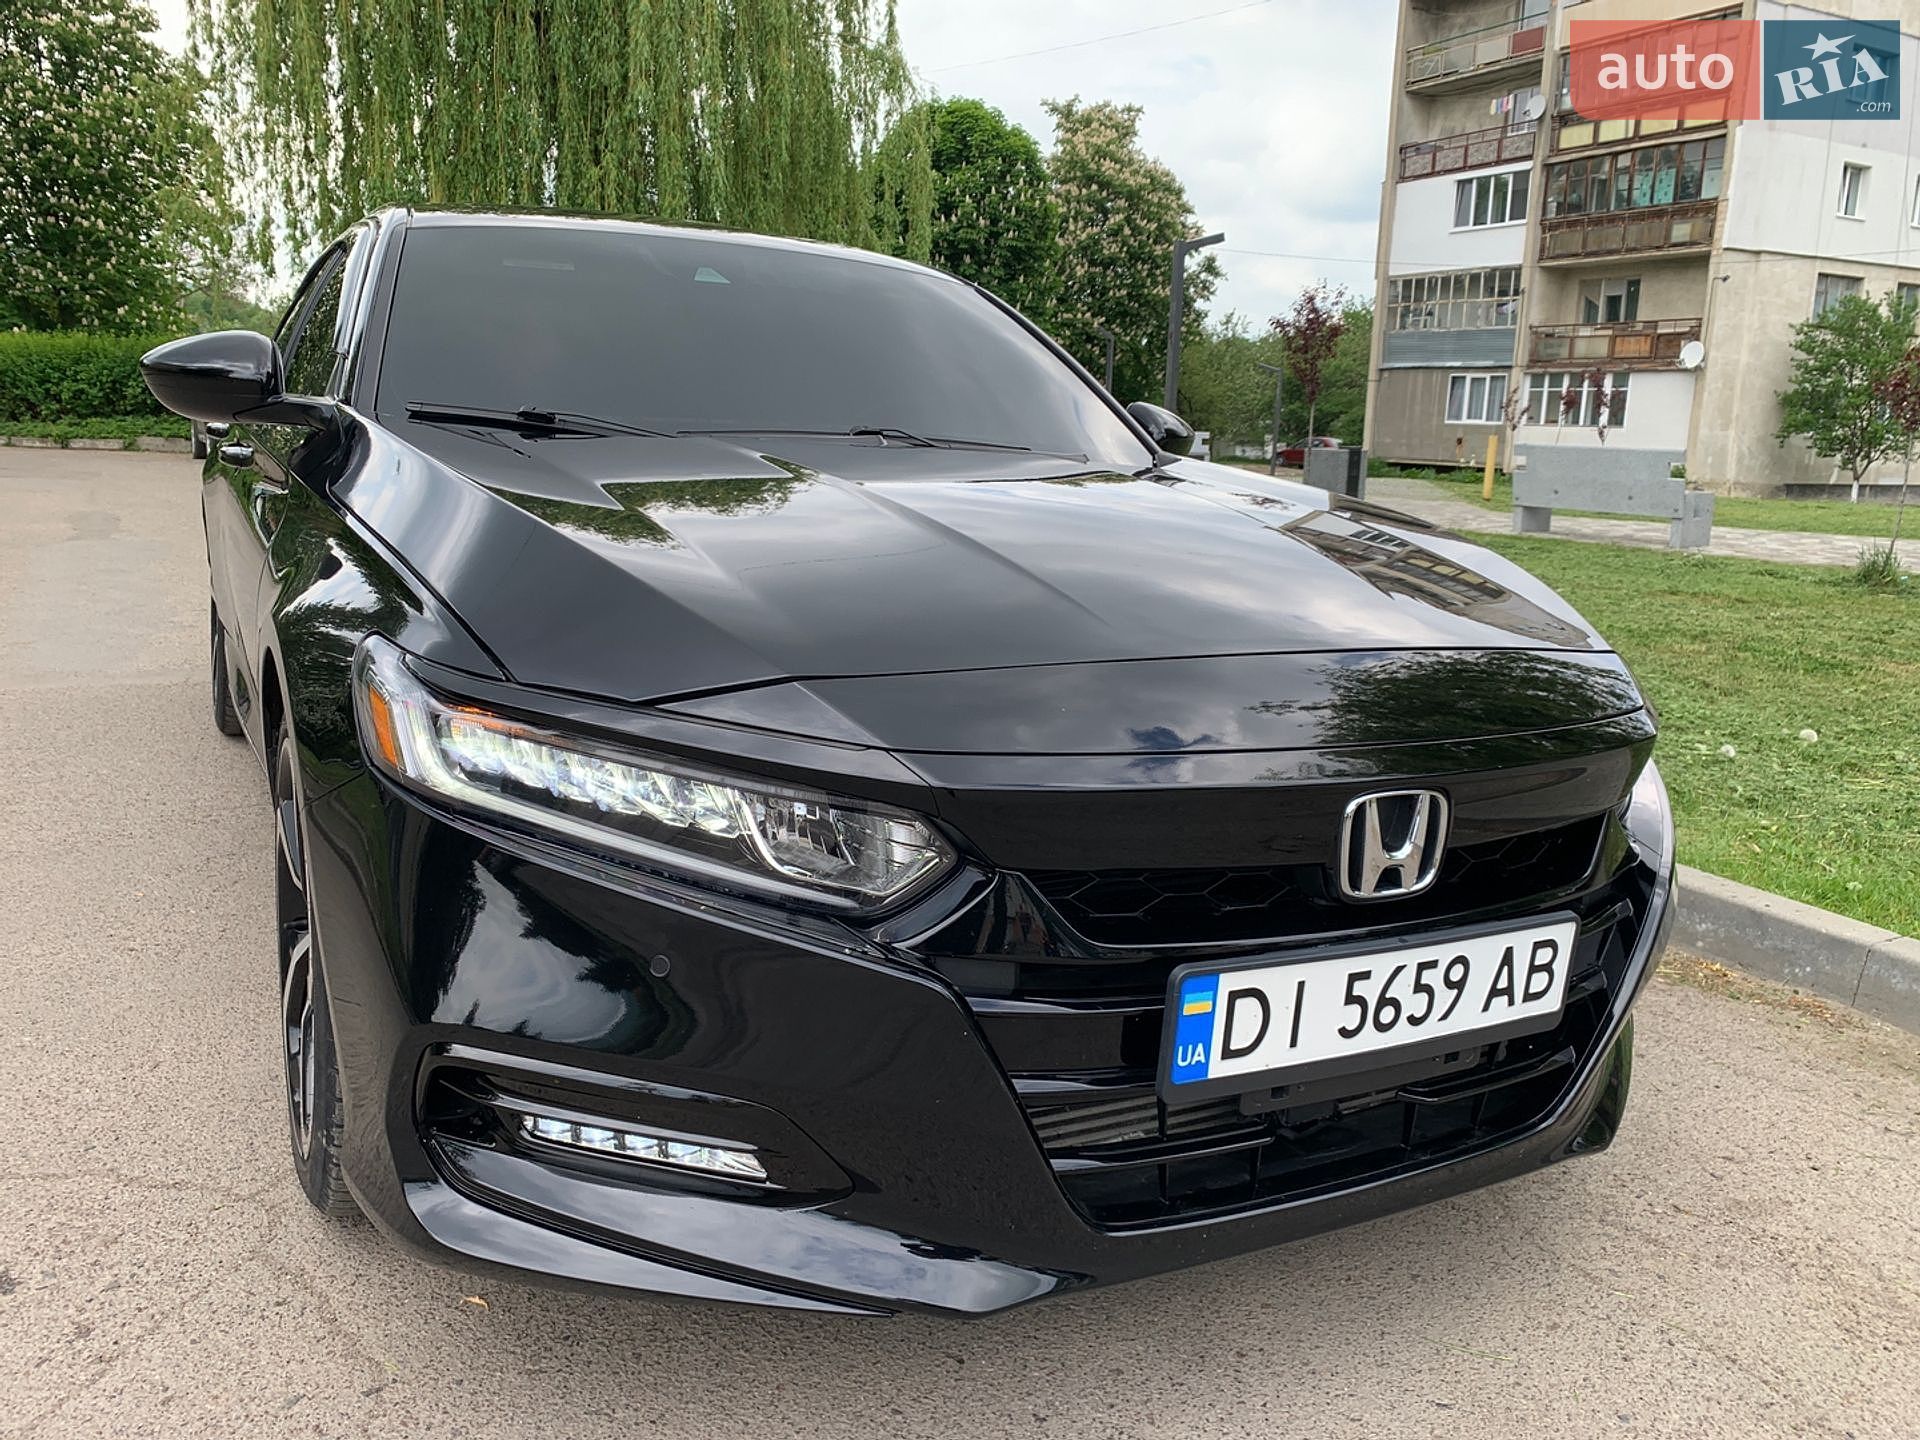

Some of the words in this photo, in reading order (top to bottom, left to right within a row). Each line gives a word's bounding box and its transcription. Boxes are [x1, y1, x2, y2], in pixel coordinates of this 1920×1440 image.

[1221, 980, 1306, 1061] DI
[1337, 954, 1470, 1039] 5659
[1481, 938, 1559, 1013] AB
[1177, 1043, 1206, 1067] UA
